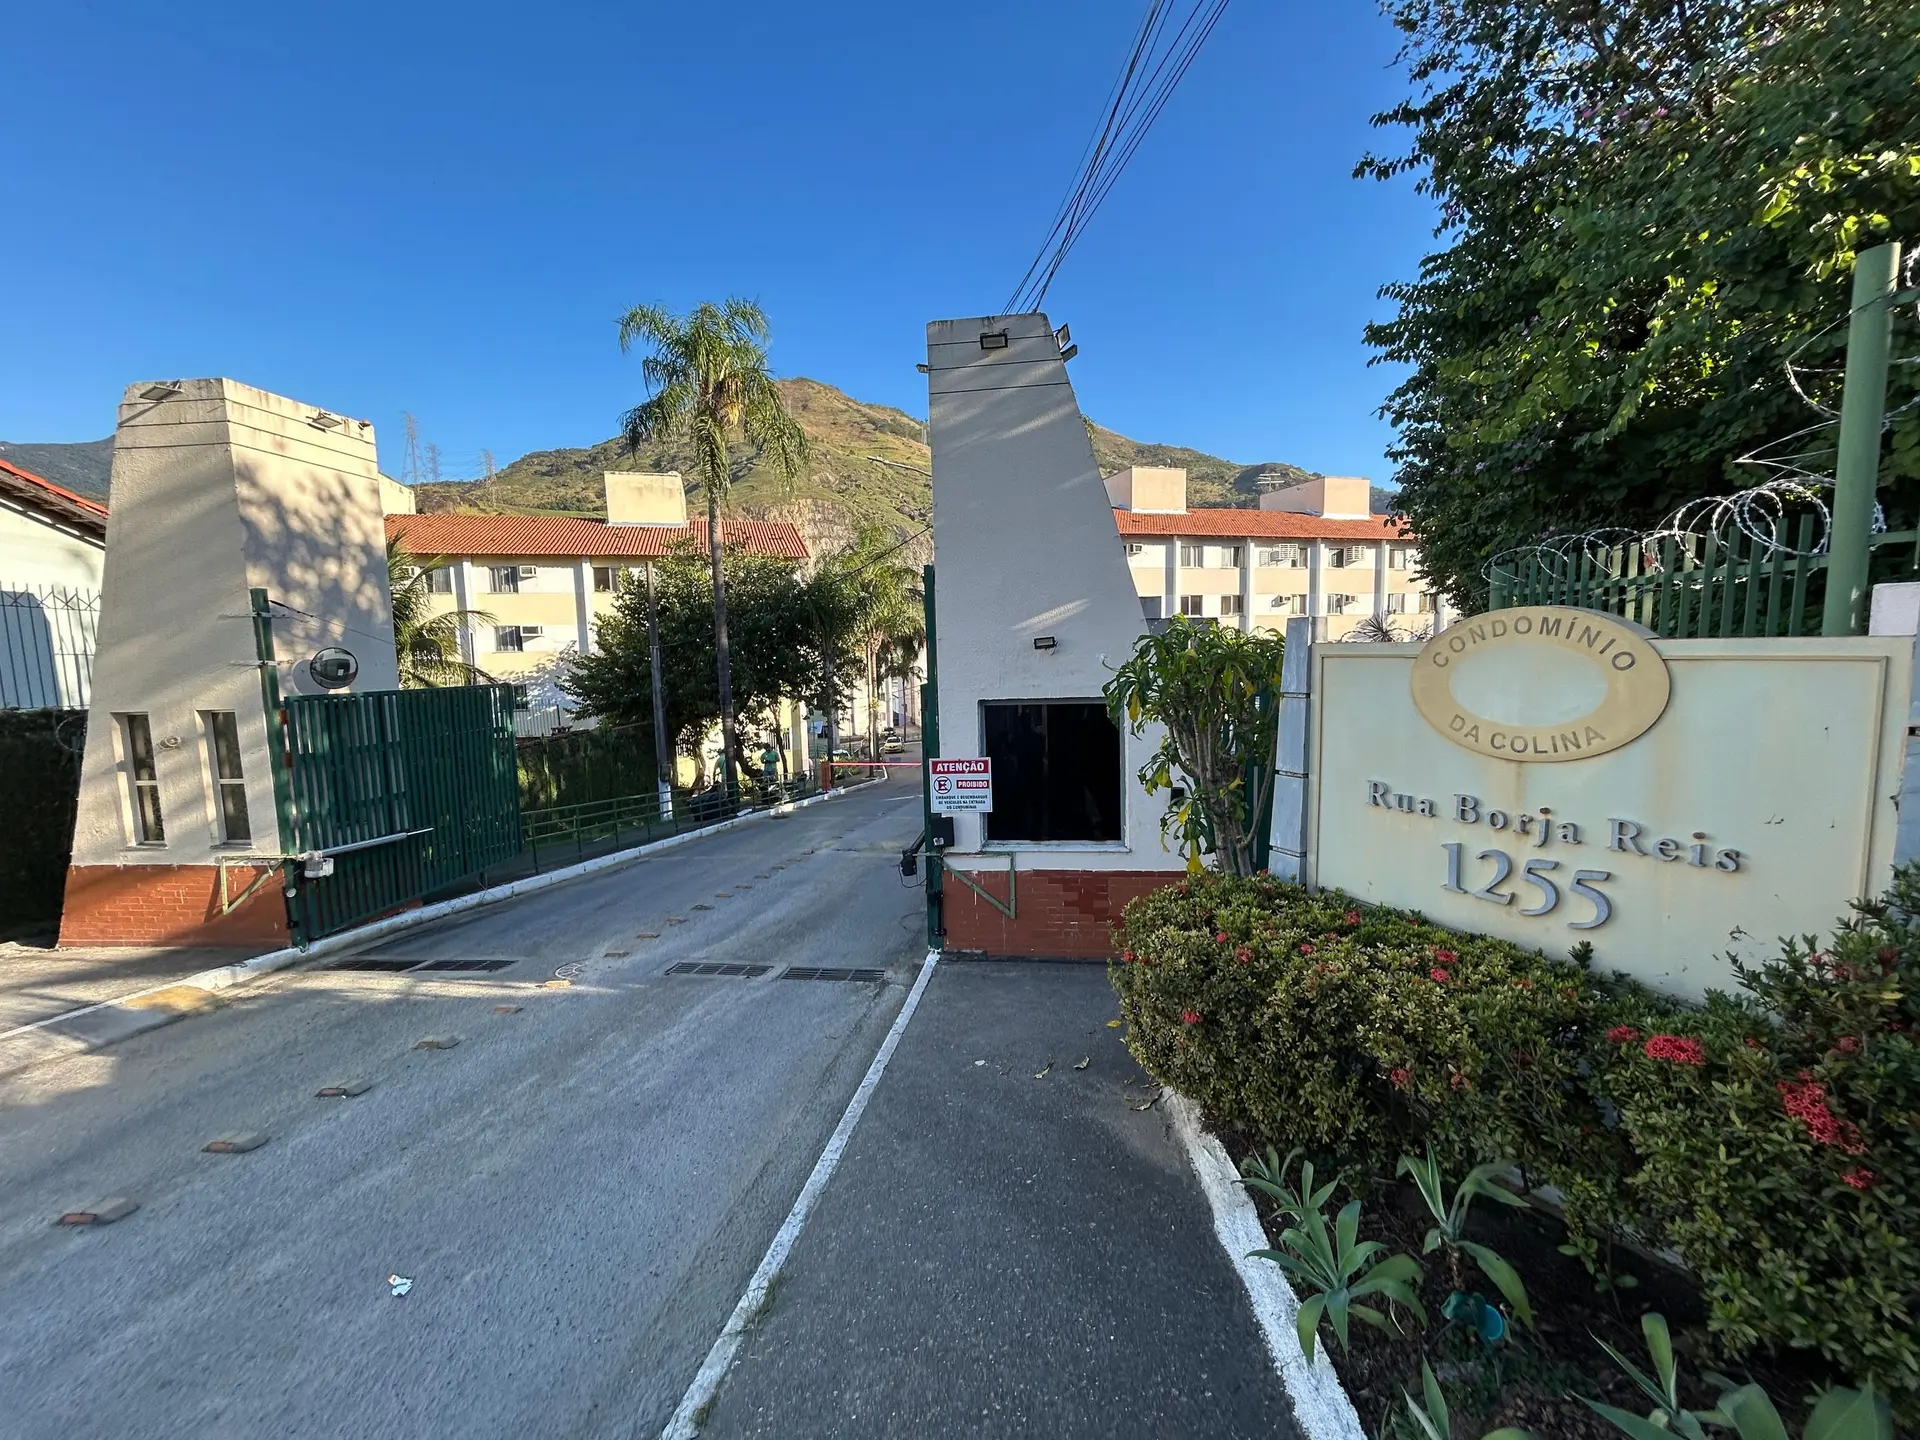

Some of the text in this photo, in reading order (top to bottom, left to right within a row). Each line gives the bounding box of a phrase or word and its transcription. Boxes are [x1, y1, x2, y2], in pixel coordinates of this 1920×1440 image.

[1432, 615, 1636, 672] CONDOMÍNIO
[1449, 713, 1607, 754] DA COLINA
[936, 761, 985, 774] ATENÇÃO
[957, 780, 988, 788] PROIBIDO
[1366, 779, 1741, 873] Rua Borja Reis
[1440, 842, 1612, 930] 1255
